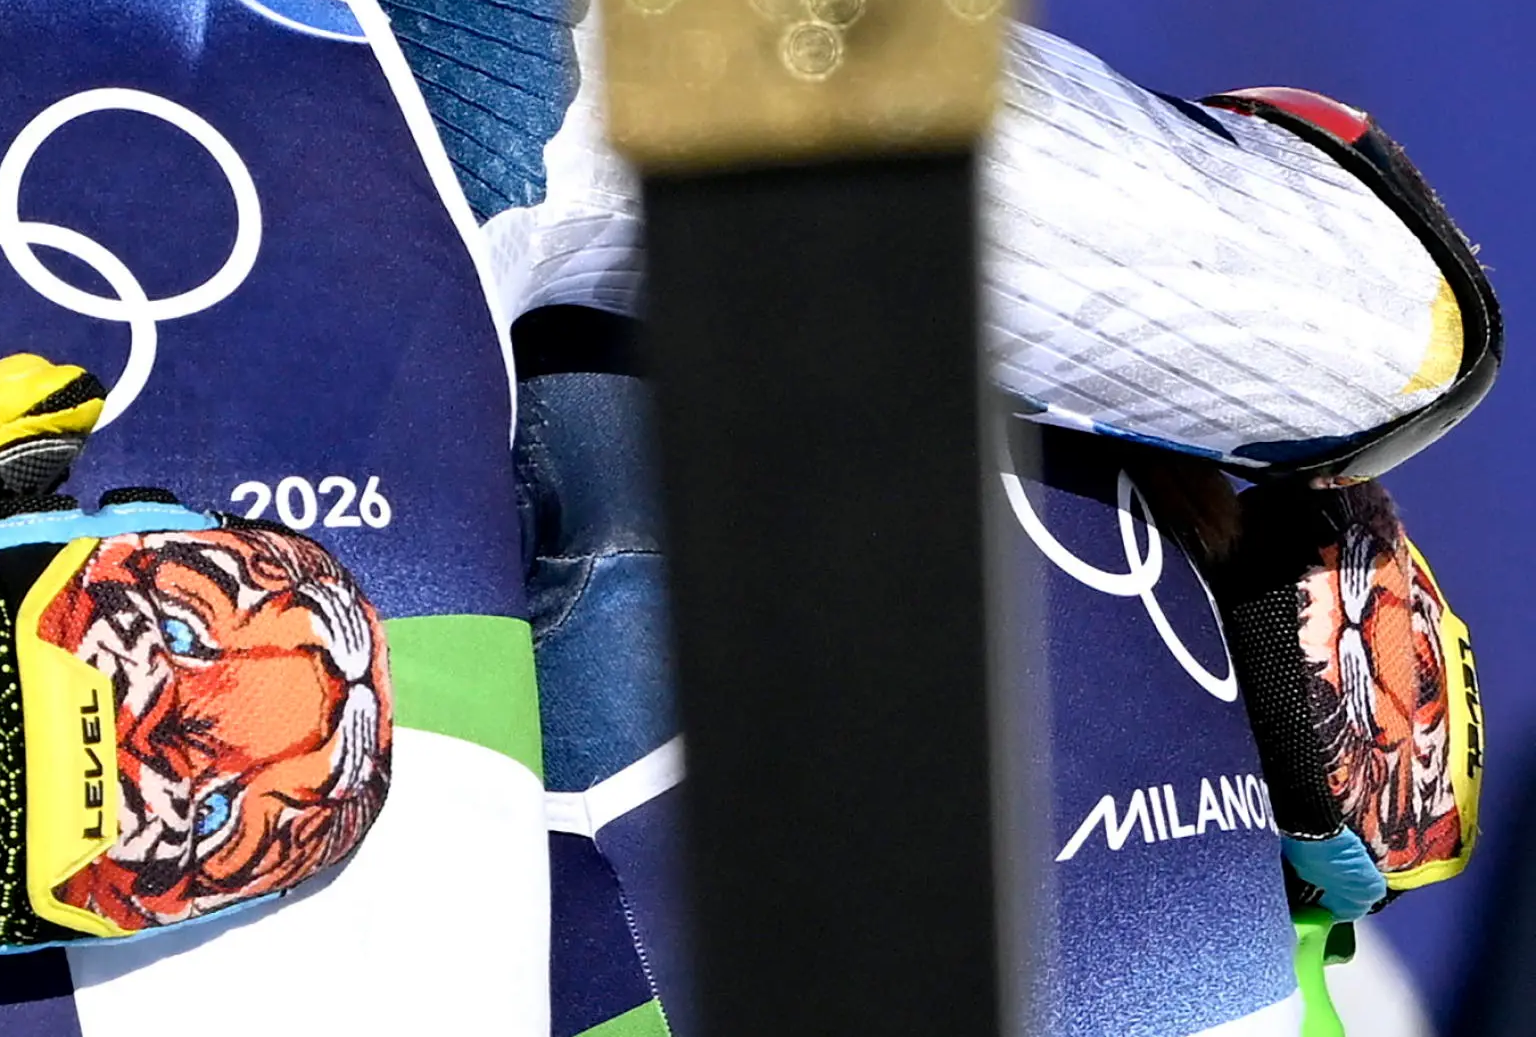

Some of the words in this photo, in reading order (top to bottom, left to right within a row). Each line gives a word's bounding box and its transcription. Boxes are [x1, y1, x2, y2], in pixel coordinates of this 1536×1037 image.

[230, 475, 392, 530] 2026
[80, 688, 104, 839] LEVEL
[1055, 773, 1267, 862] MILANO
